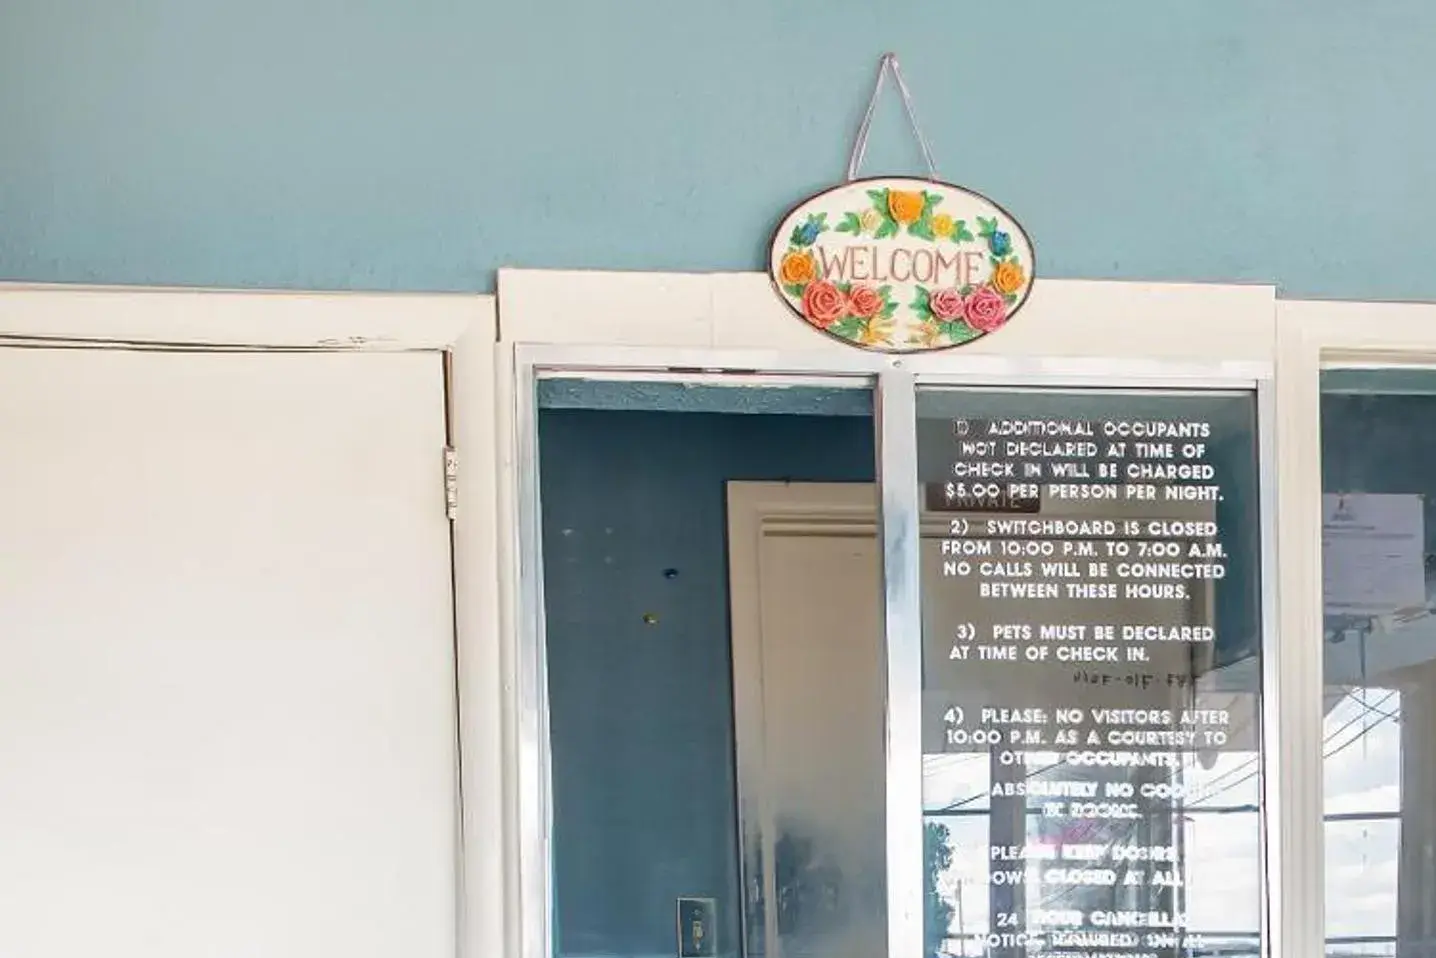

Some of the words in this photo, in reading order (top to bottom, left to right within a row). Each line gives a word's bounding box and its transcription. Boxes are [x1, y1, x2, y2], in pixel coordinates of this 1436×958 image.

[817, 245, 984, 285] WELCOME
[988, 420, 1094, 436] ADDITIONAL
[1103, 420, 1211, 438] OCCUPANTS
[962, 441, 996, 456] NOT
[1006, 441, 1098, 458] DECLARED
[1107, 442, 1127, 458] AT
[1135, 442, 1175, 459] TIME
[1182, 443, 1206, 459] OF
[955, 462, 1014, 478] CHECK
[1024, 462, 1042, 478] IN
[1051, 462, 1090, 478] WILL
[1098, 462, 1118, 478] BE
[1127, 463, 1215, 480] CHARGED
[1009, 483, 1039, 499] PER
[1048, 483, 1118, 500] PERSON
[1126, 484, 1156, 500] PER
[1165, 485, 1225, 502] NIGHT.
[950, 518, 970, 536] 2)
[987, 520, 1116, 536] SWITCHBOARD
[1125, 520, 1141, 536] IS
[1148, 521, 1218, 537] CLOSED
[942, 540, 992, 556] FROM
[1001, 540, 1055, 557] 10:00
[1063, 541, 1099, 557] P.M.
[1106, 541, 1131, 557] TO
[1137, 542, 1181, 558] 7:00
[1188, 543, 1228, 559] A.M.
[943, 561, 972, 577] NO
[980, 562, 1033, 577] CALLS
[1041, 562, 1081, 578] WILL
[1088, 562, 1109, 578] BE
[1117, 562, 1226, 579] CONNECTED
[979, 582, 1060, 599] BETWEEN
[1066, 583, 1118, 599] THESE
[1125, 583, 1192, 600] HOURS.
[957, 622, 976, 641] 3)
[992, 624, 1033, 640] PETS
[1040, 625, 1087, 641] MUST
[1094, 625, 1115, 641] BE
[1122, 625, 1215, 642] DECLARED
[949, 646, 970, 661] AT
[978, 646, 1017, 661] TIME
[1025, 646, 1049, 662] OF
[1056, 646, 1119, 662] CHECK
[1127, 646, 1150, 662] IN.
[943, 707, 964, 725] 4)
[1056, 708, 1084, 724] NO
[1091, 709, 1172, 725] VISITORS
[946, 729, 1002, 745] 10:00
[1010, 729, 1047, 745] P.M.
[1054, 730, 1079, 745] AS
[1086, 730, 1101, 745] A
[1107, 730, 1196, 746] COURTESY
[1204, 729, 1227, 746] TO
[1104, 782, 1135, 798] NO
[1123, 870, 1146, 886] AT
[996, 912, 1019, 927] 24
